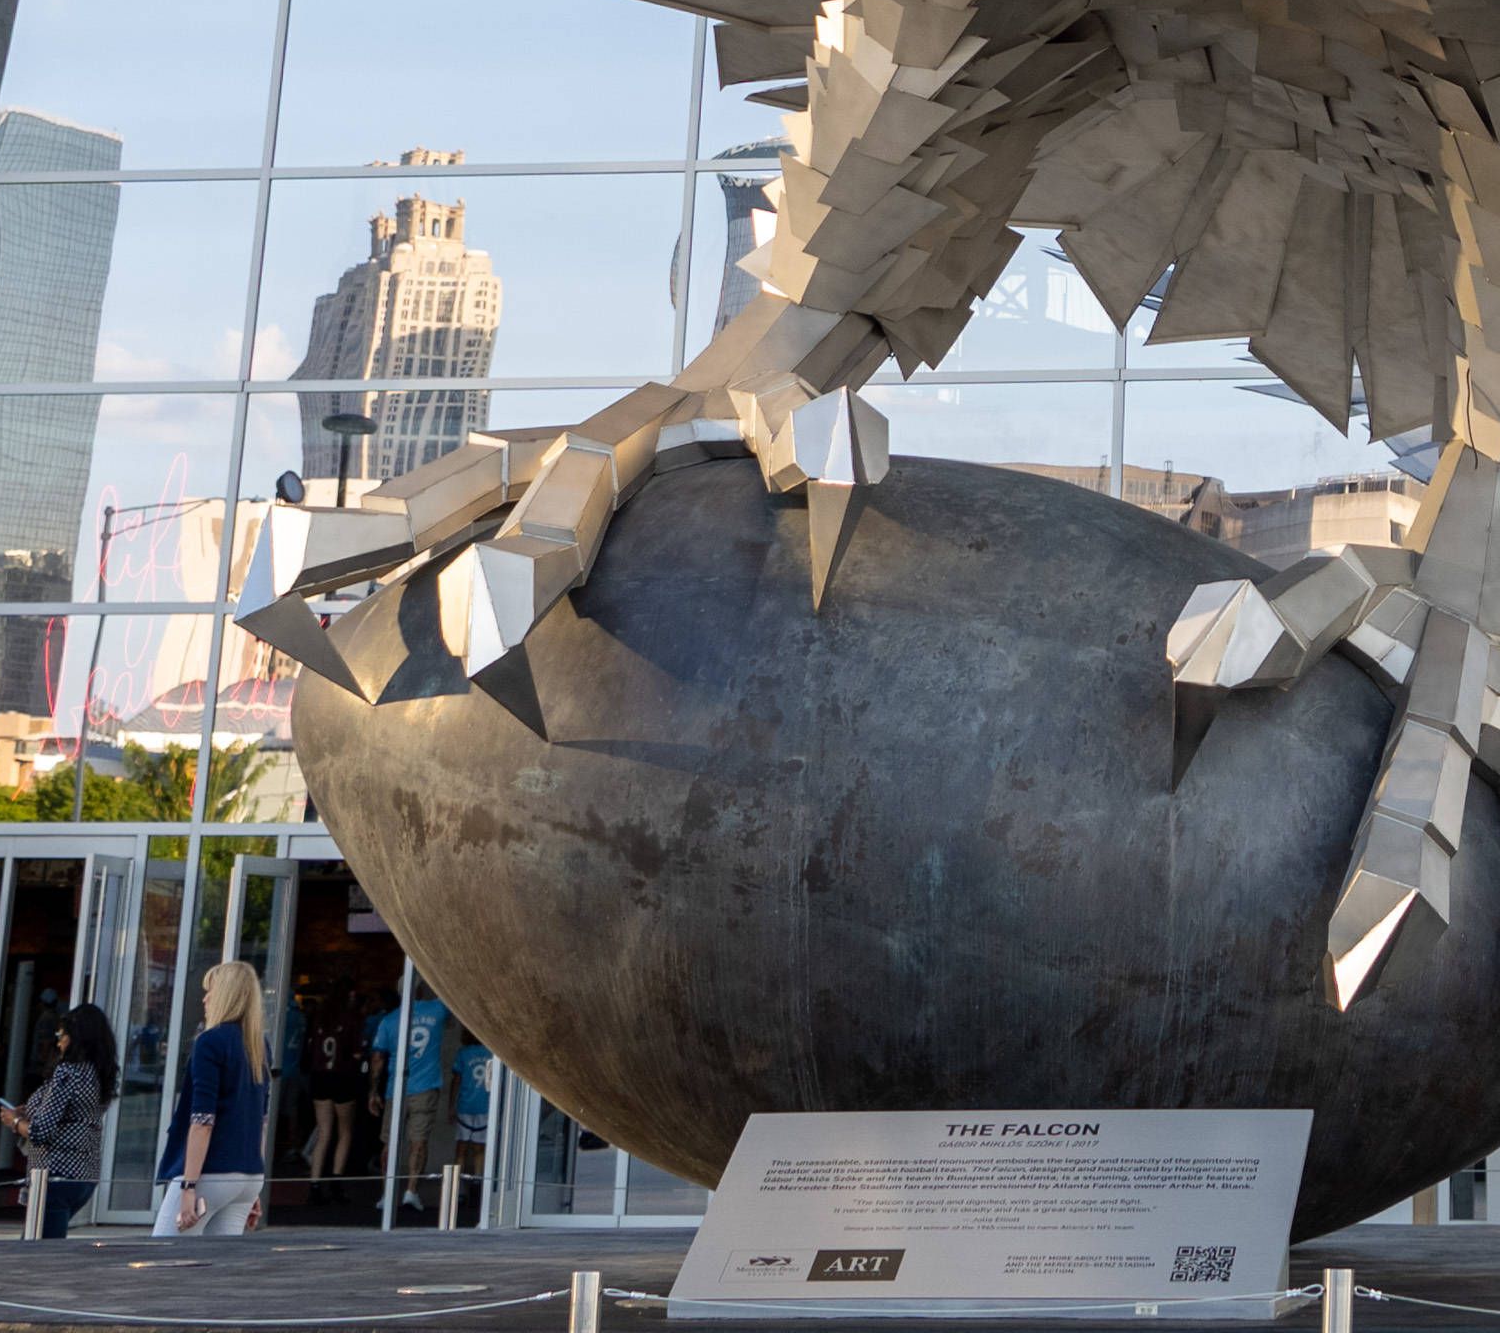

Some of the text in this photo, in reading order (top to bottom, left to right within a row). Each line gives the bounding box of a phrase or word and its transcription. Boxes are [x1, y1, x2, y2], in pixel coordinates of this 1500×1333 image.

[411, 1026, 430, 1059] 9
[323, 1037, 337, 1070] 9
[945, 1123, 1100, 1136] THE FALCON
[1071, 1140, 1100, 1148] 2017
[795, 1159, 861, 1167] unassailable,
[1064, 1158, 1098, 1166] legacy
[1120, 1157, 1162, 1166] tenacity
[1192, 1157, 1259, 1165] pointed-wing
[766, 1167, 811, 1175] predator
[1029, 1166, 1076, 1174] designed
[1161, 1166, 1172, 1174] by
[1174, 1166, 1228, 1174] Hungarian
[946, 1175, 995, 1183] Budapest
[1019, 1175, 1059, 1183] Atlanta,
[1082, 1174, 1131, 1182] stunning,
[1133, 1174, 1204, 1182] unforgettable
[823, 1256, 889, 1272] ART
